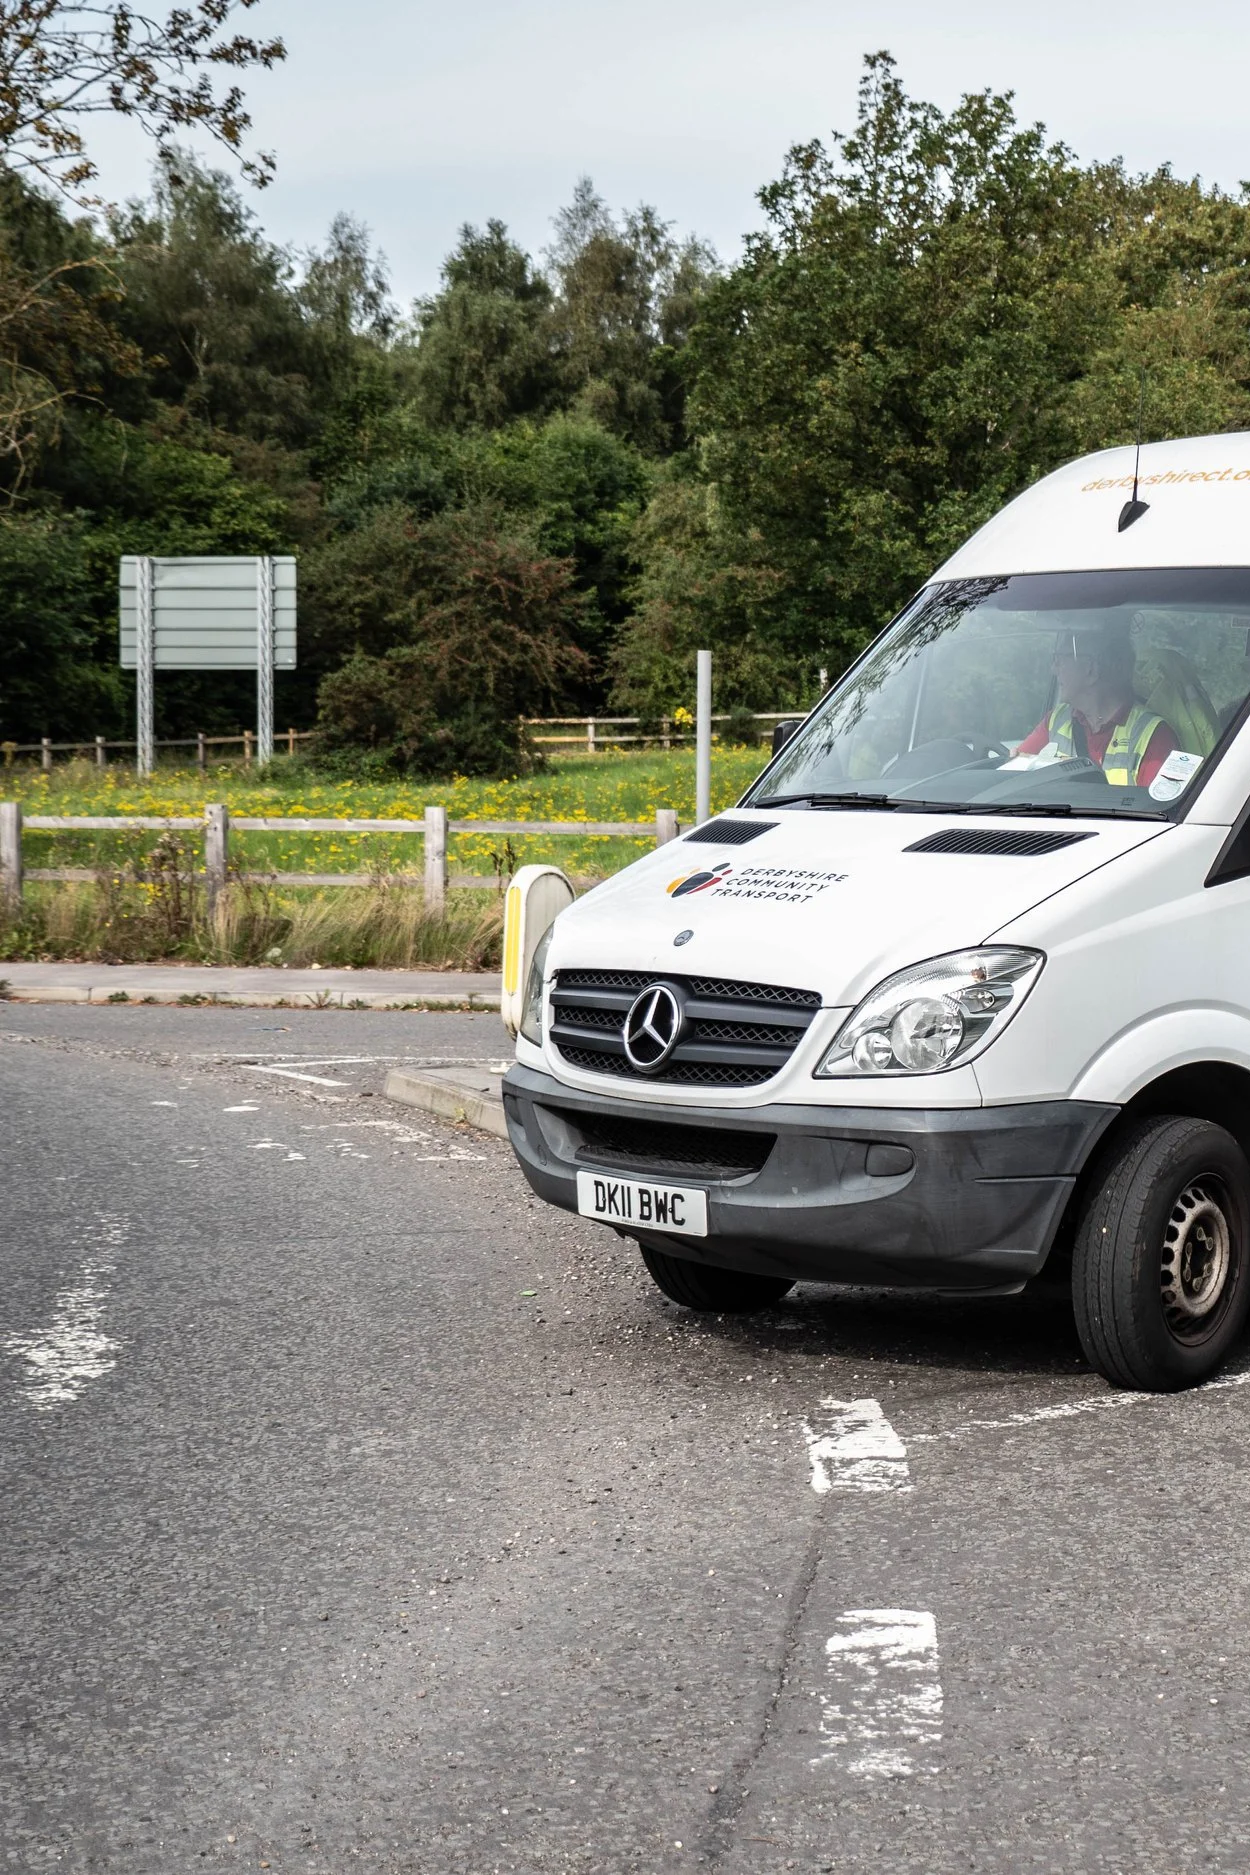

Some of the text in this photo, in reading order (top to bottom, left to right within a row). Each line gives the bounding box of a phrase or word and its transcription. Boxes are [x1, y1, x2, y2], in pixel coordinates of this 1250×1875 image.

[740, 868, 849, 883] DERBYSHIRE
[726, 878, 830, 893] COMMUNITY
[710, 888, 813, 903] TRANSPORT
[594, 1180, 686, 1226] DK11 BWC
